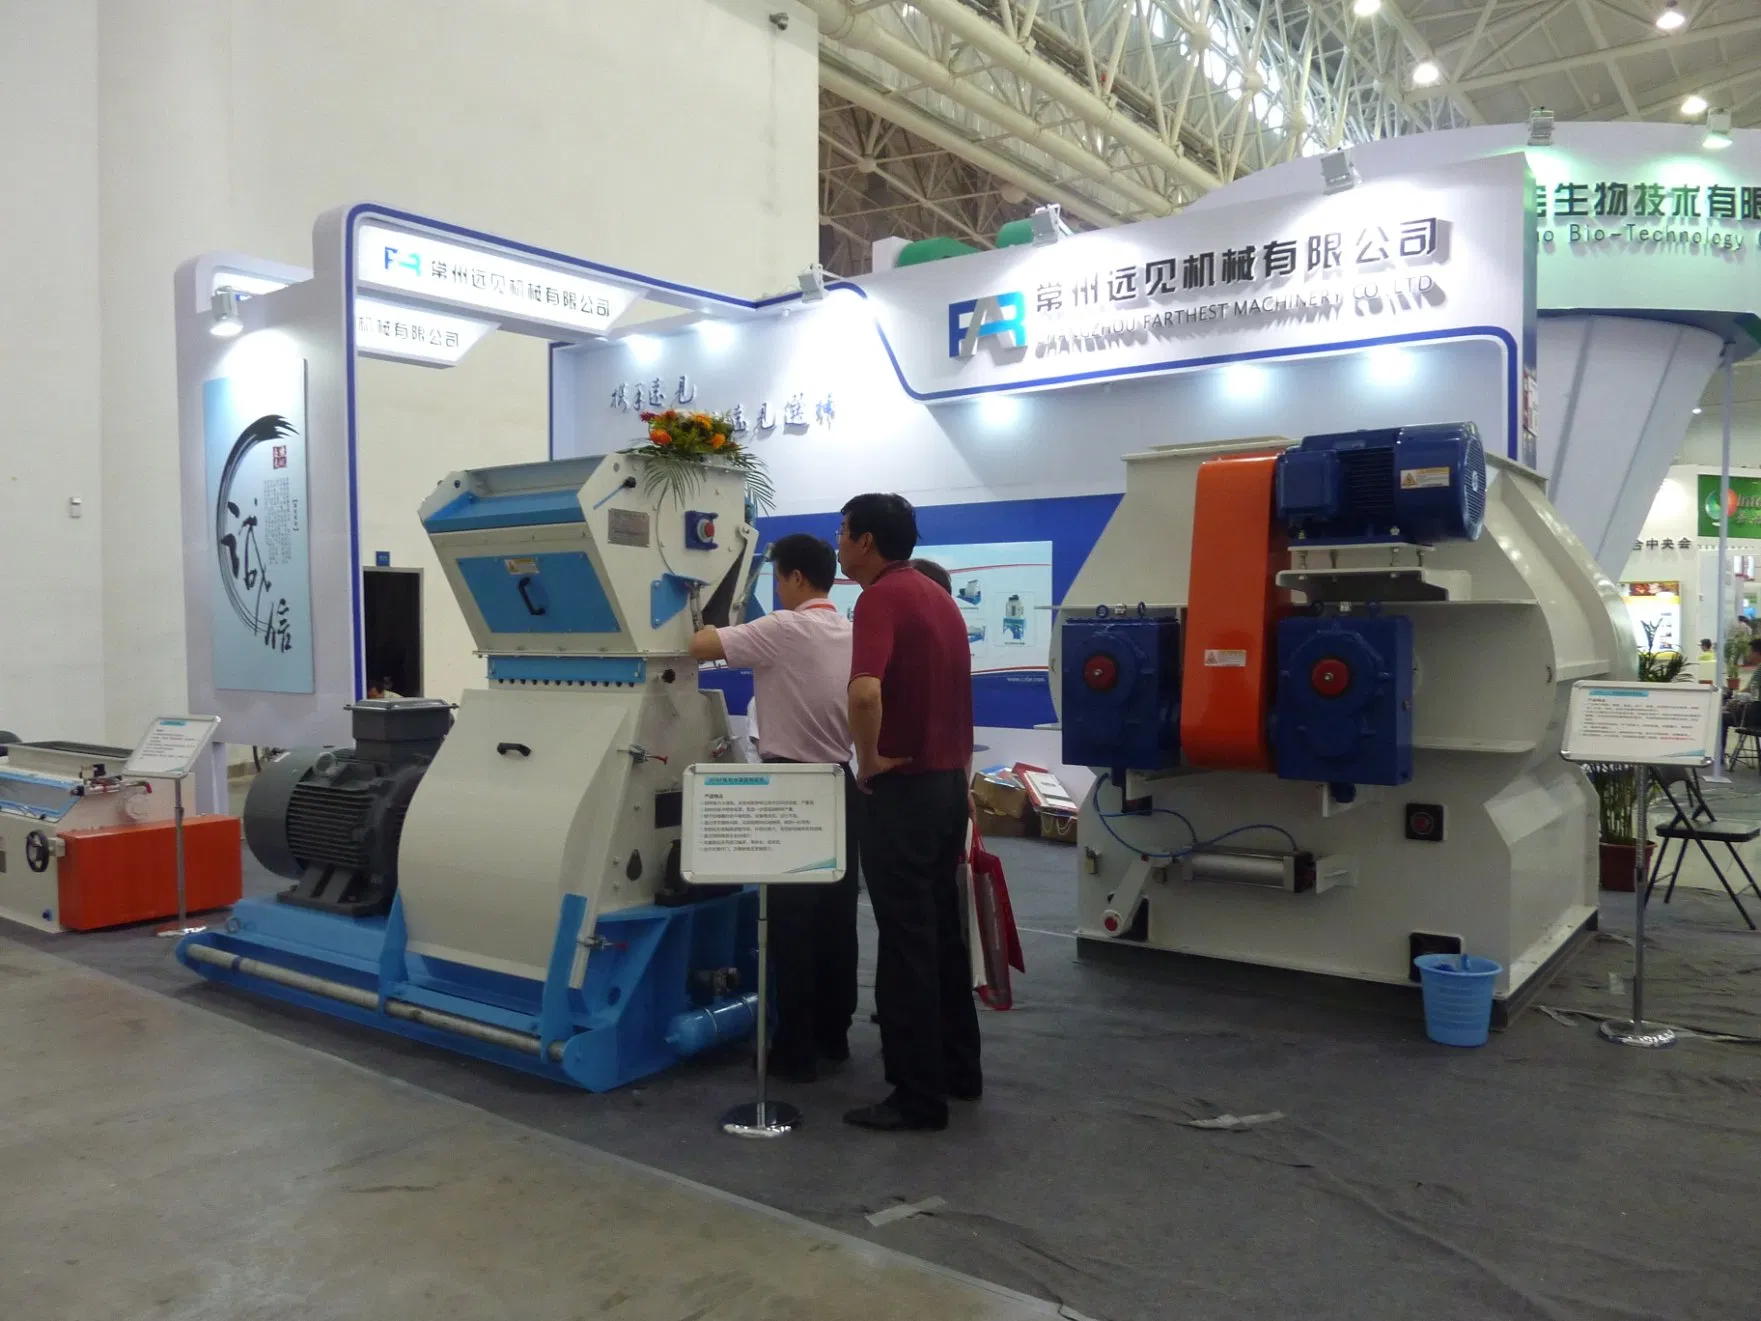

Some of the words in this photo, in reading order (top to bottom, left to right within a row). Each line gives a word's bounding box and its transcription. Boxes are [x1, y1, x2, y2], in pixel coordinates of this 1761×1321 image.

[1569, 224, 1744, 249] Bio-Technology
[1037, 217, 1437, 312] 常州远见机械有限公司
[431, 259, 610, 317] 常州远见机械有限公司
[1143, 302, 1229, 329] FARTHEST
